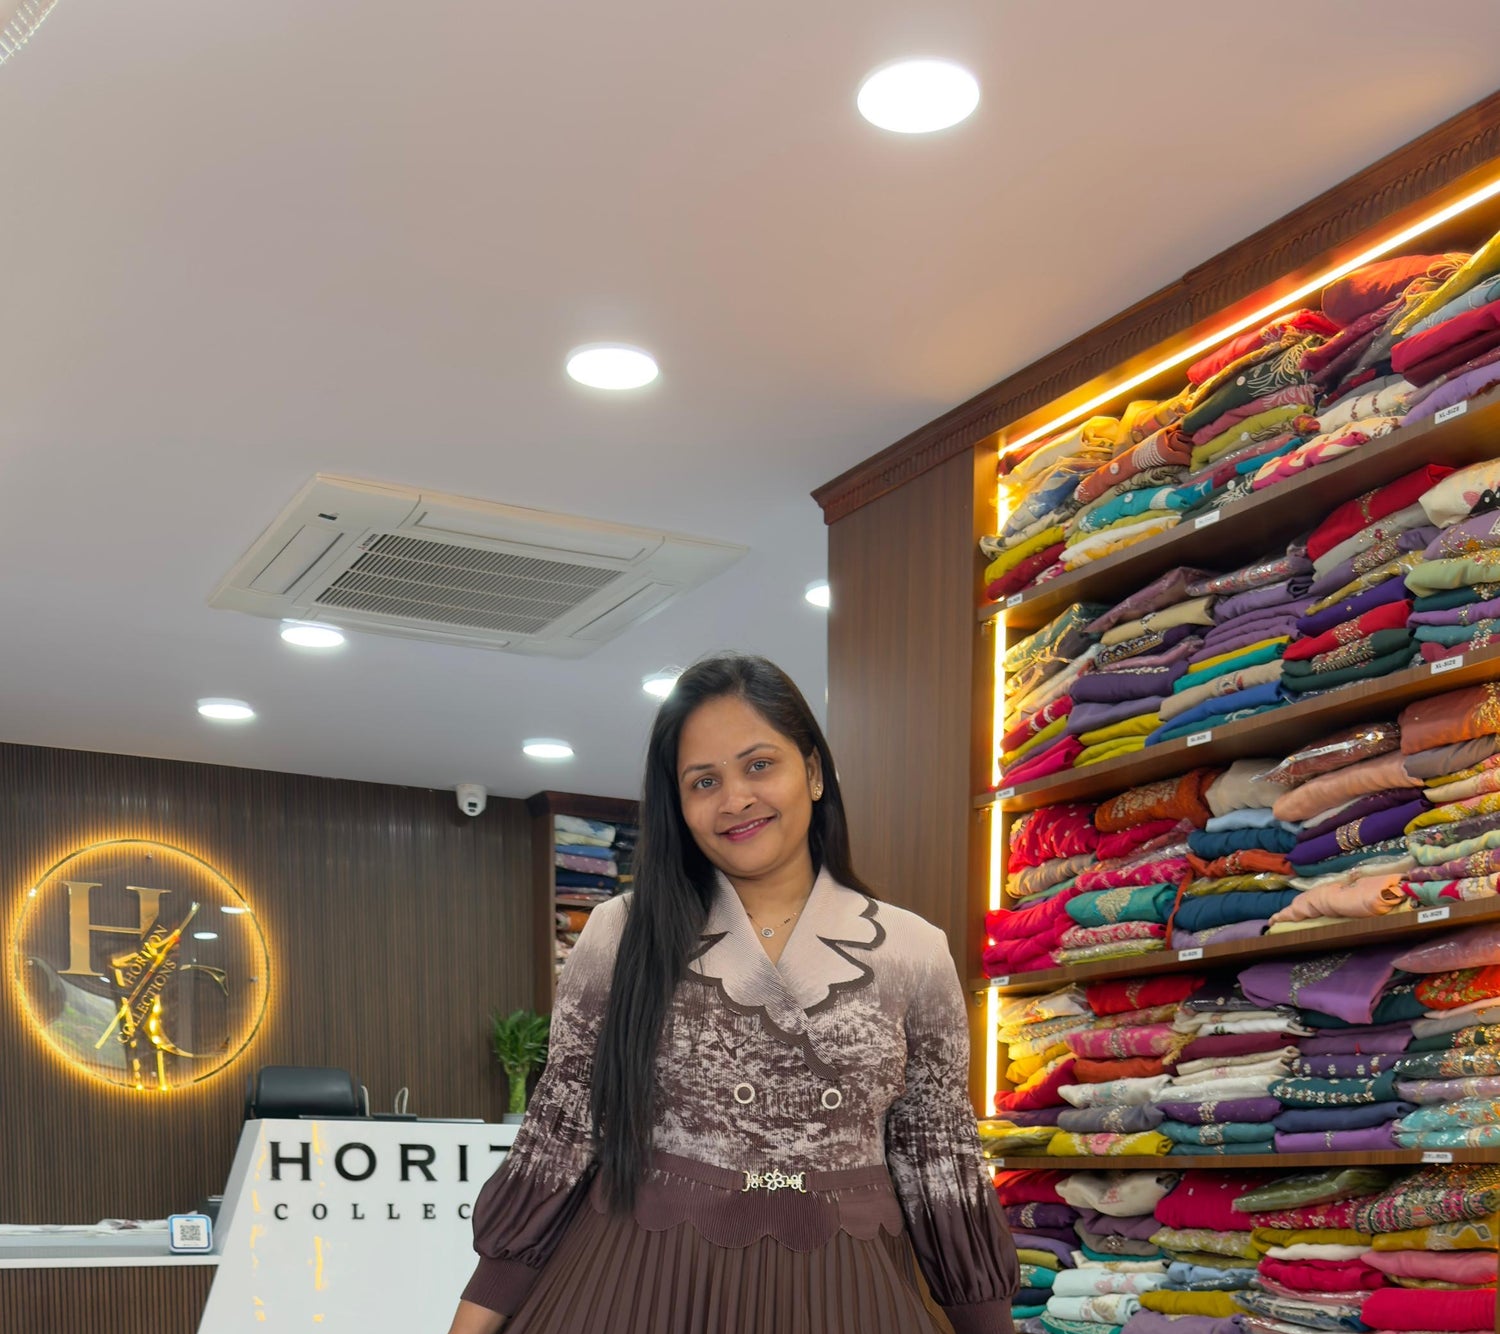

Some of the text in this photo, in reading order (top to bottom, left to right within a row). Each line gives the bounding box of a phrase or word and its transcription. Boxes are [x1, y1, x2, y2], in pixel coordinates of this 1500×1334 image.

[1439, 406, 1460, 418] XL-SIZE
[1435, 659, 1456, 669] XL-SIZE
[274, 1203, 472, 1221] COLLEC
